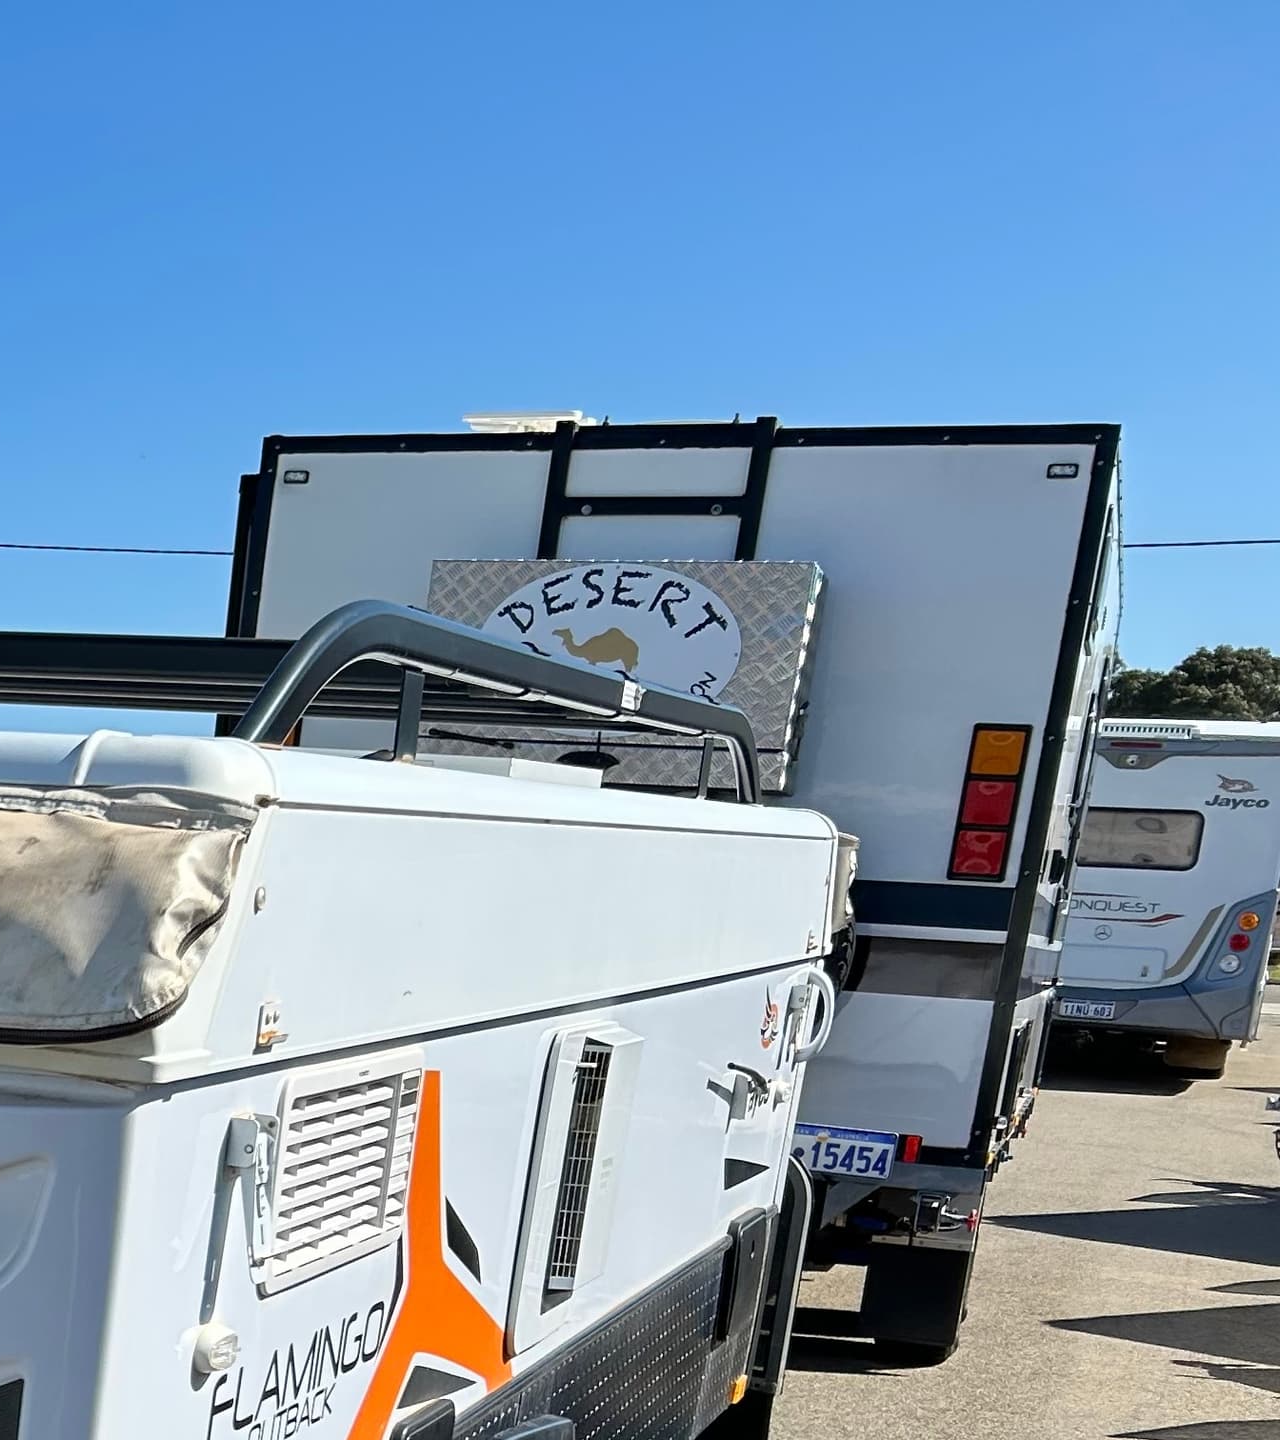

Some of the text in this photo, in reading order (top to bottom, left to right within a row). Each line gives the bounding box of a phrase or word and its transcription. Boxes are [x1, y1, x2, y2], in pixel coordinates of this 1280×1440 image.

[497, 568, 729, 639] DESERT
[1204, 794, 1271, 810] Jayco
[1069, 899, 1161, 914] ONQUEST
